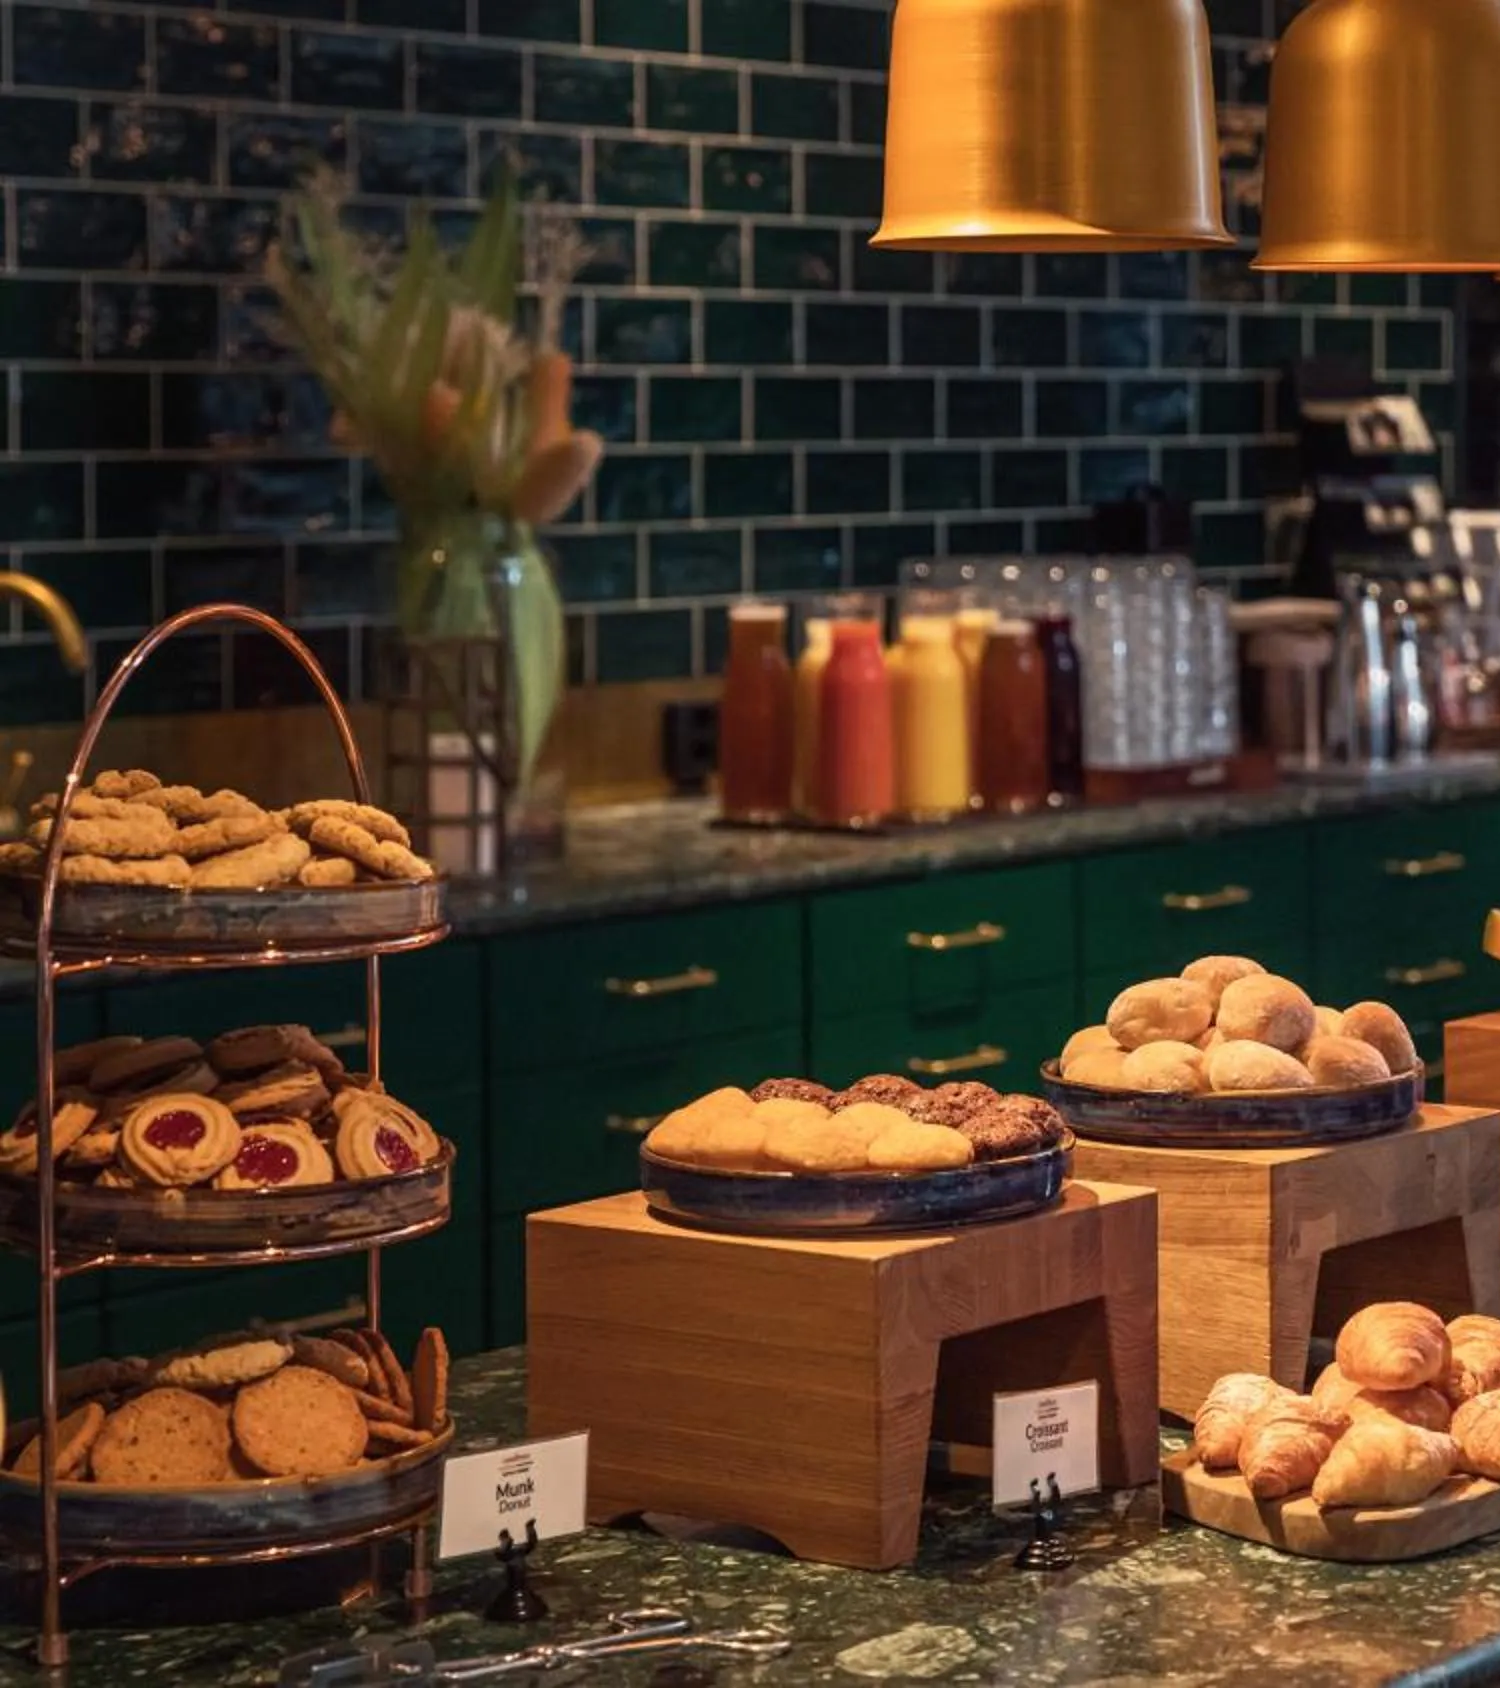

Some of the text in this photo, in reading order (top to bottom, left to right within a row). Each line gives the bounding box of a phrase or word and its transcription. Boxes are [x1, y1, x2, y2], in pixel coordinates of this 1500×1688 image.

[1026, 1420, 1069, 1440] Croissant
[496, 1478, 535, 1501] Munk
[499, 1498, 531, 1513] Donut
